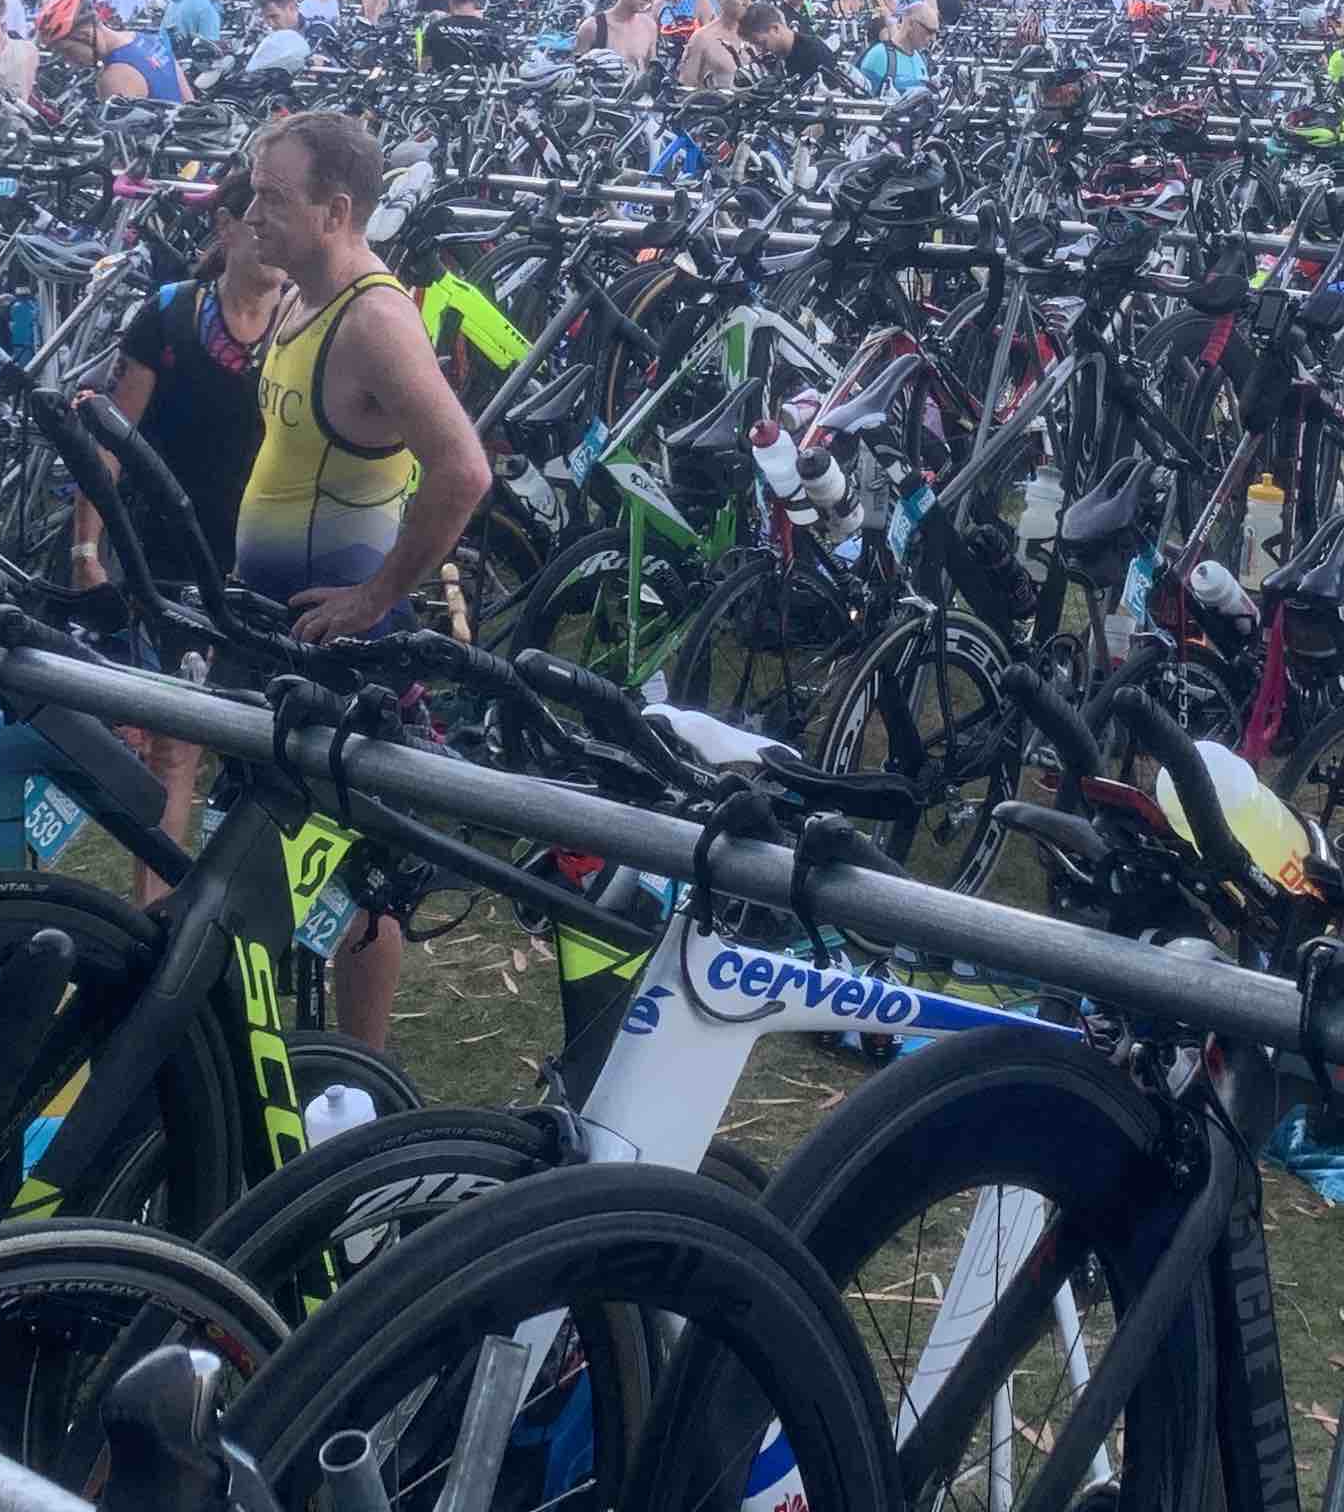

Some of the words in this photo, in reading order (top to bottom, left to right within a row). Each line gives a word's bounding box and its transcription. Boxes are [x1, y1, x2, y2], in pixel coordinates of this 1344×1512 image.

[24, 801, 64, 848] 539
[305, 909, 338, 955] 42
[707, 949, 920, 1025] cervelo
